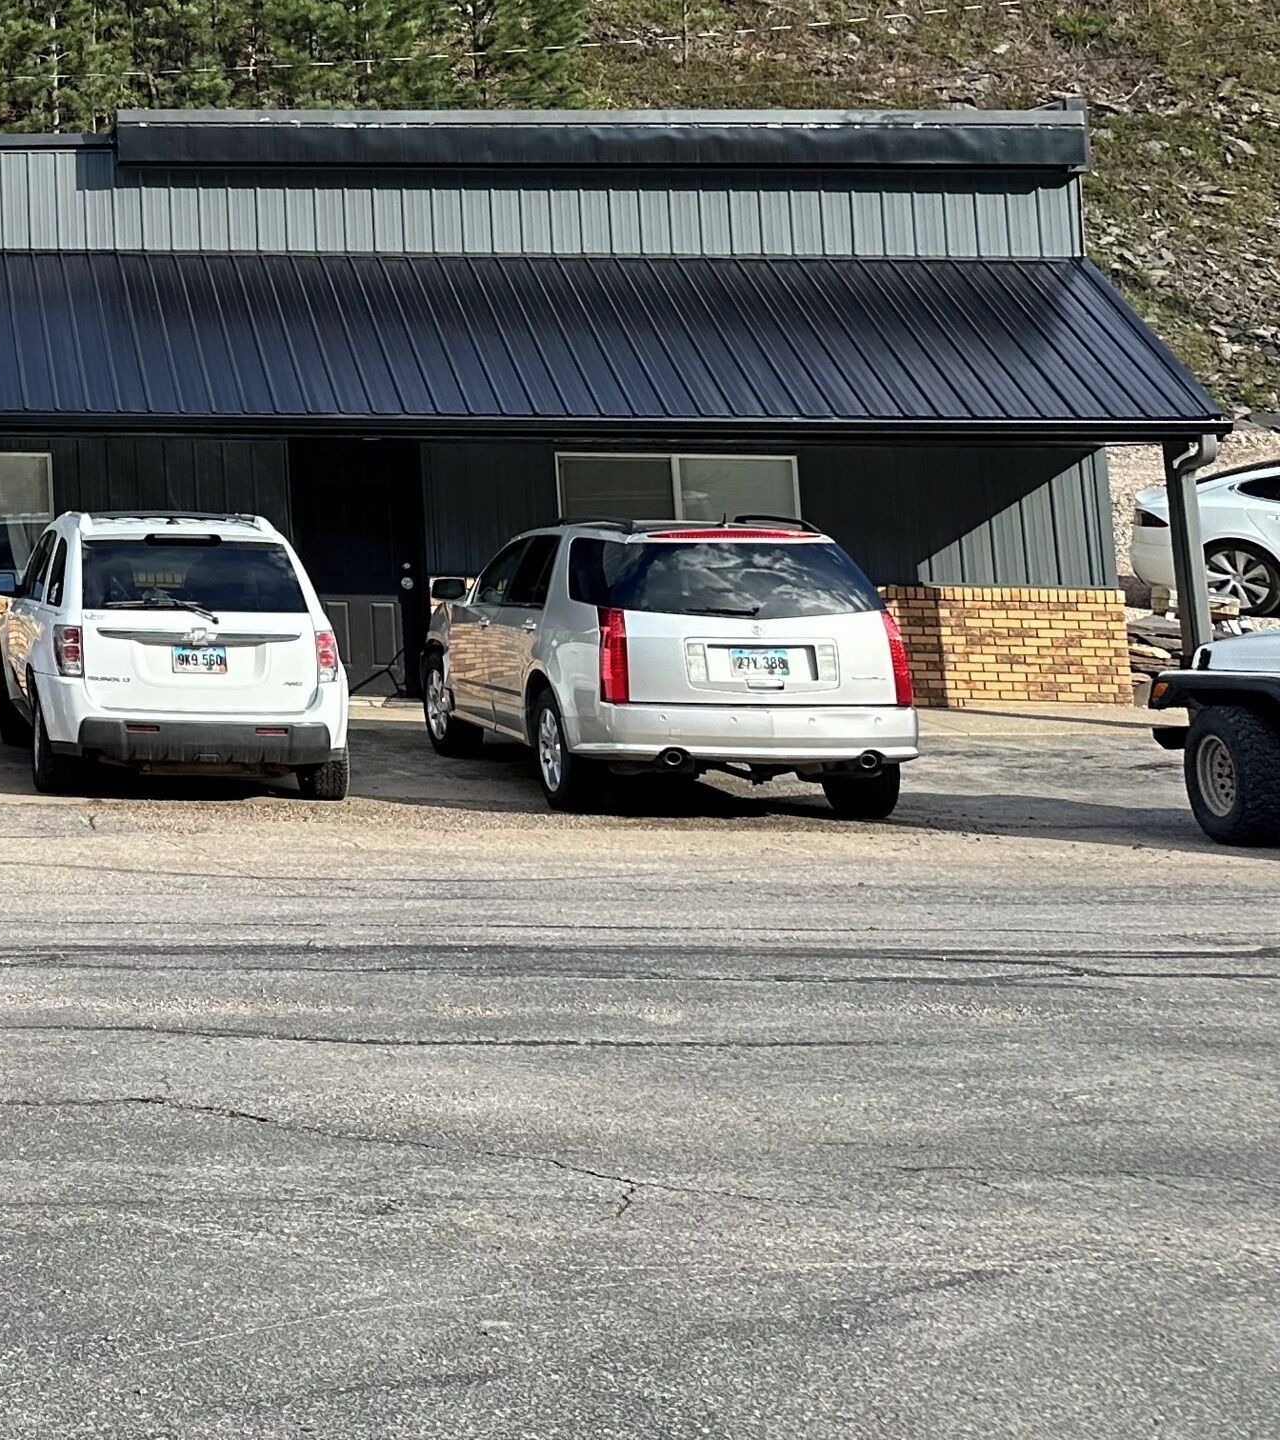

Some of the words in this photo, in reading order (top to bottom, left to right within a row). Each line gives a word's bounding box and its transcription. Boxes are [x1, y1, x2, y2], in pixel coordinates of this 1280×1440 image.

[177, 653, 198, 666] 9K9
[202, 654, 222, 667] 560
[736, 656, 758, 670] 27Y
[762, 656, 785, 670] 388
